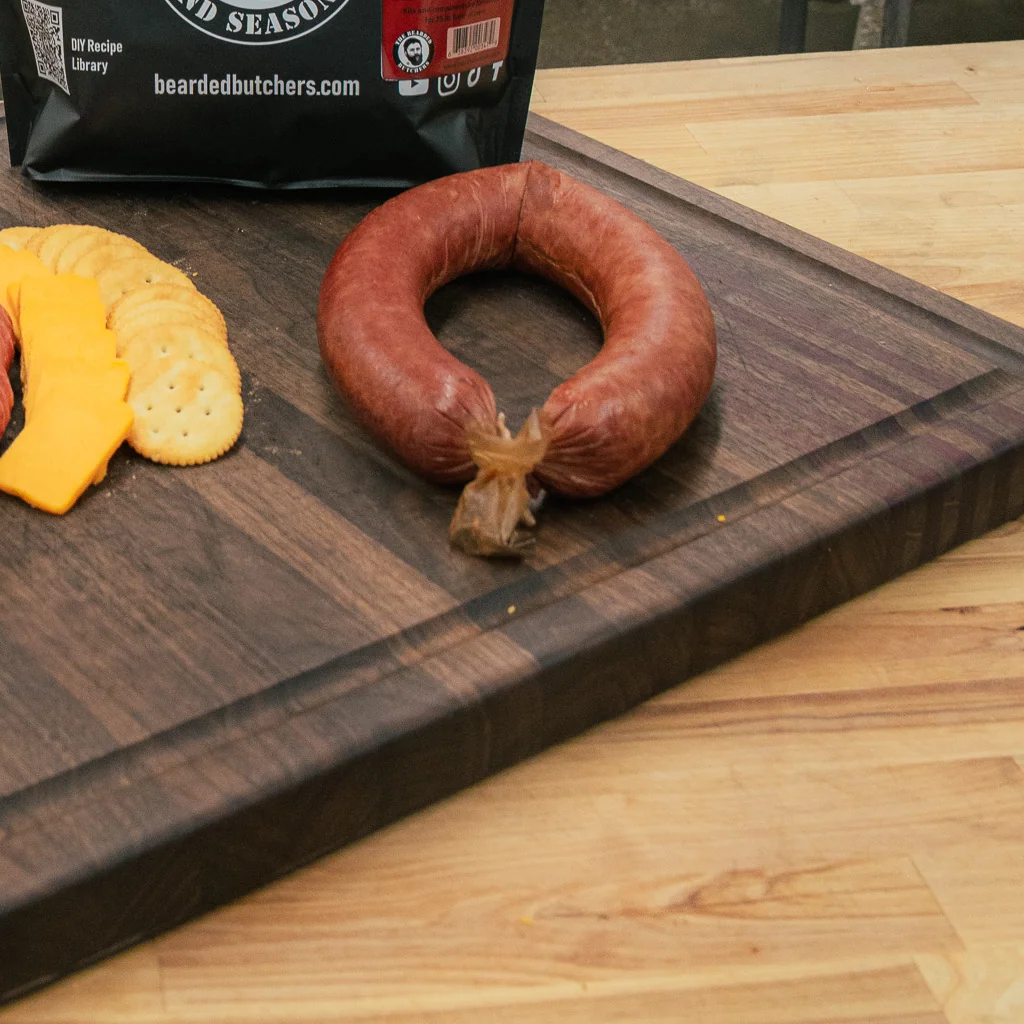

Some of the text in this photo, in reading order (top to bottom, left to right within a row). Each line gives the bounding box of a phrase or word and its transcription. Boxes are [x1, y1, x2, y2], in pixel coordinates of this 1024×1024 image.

[71, 38, 123, 55] DIY Recipe
[72, 57, 108, 75] Library
[154, 73, 361, 96] beardedbutchers.com
